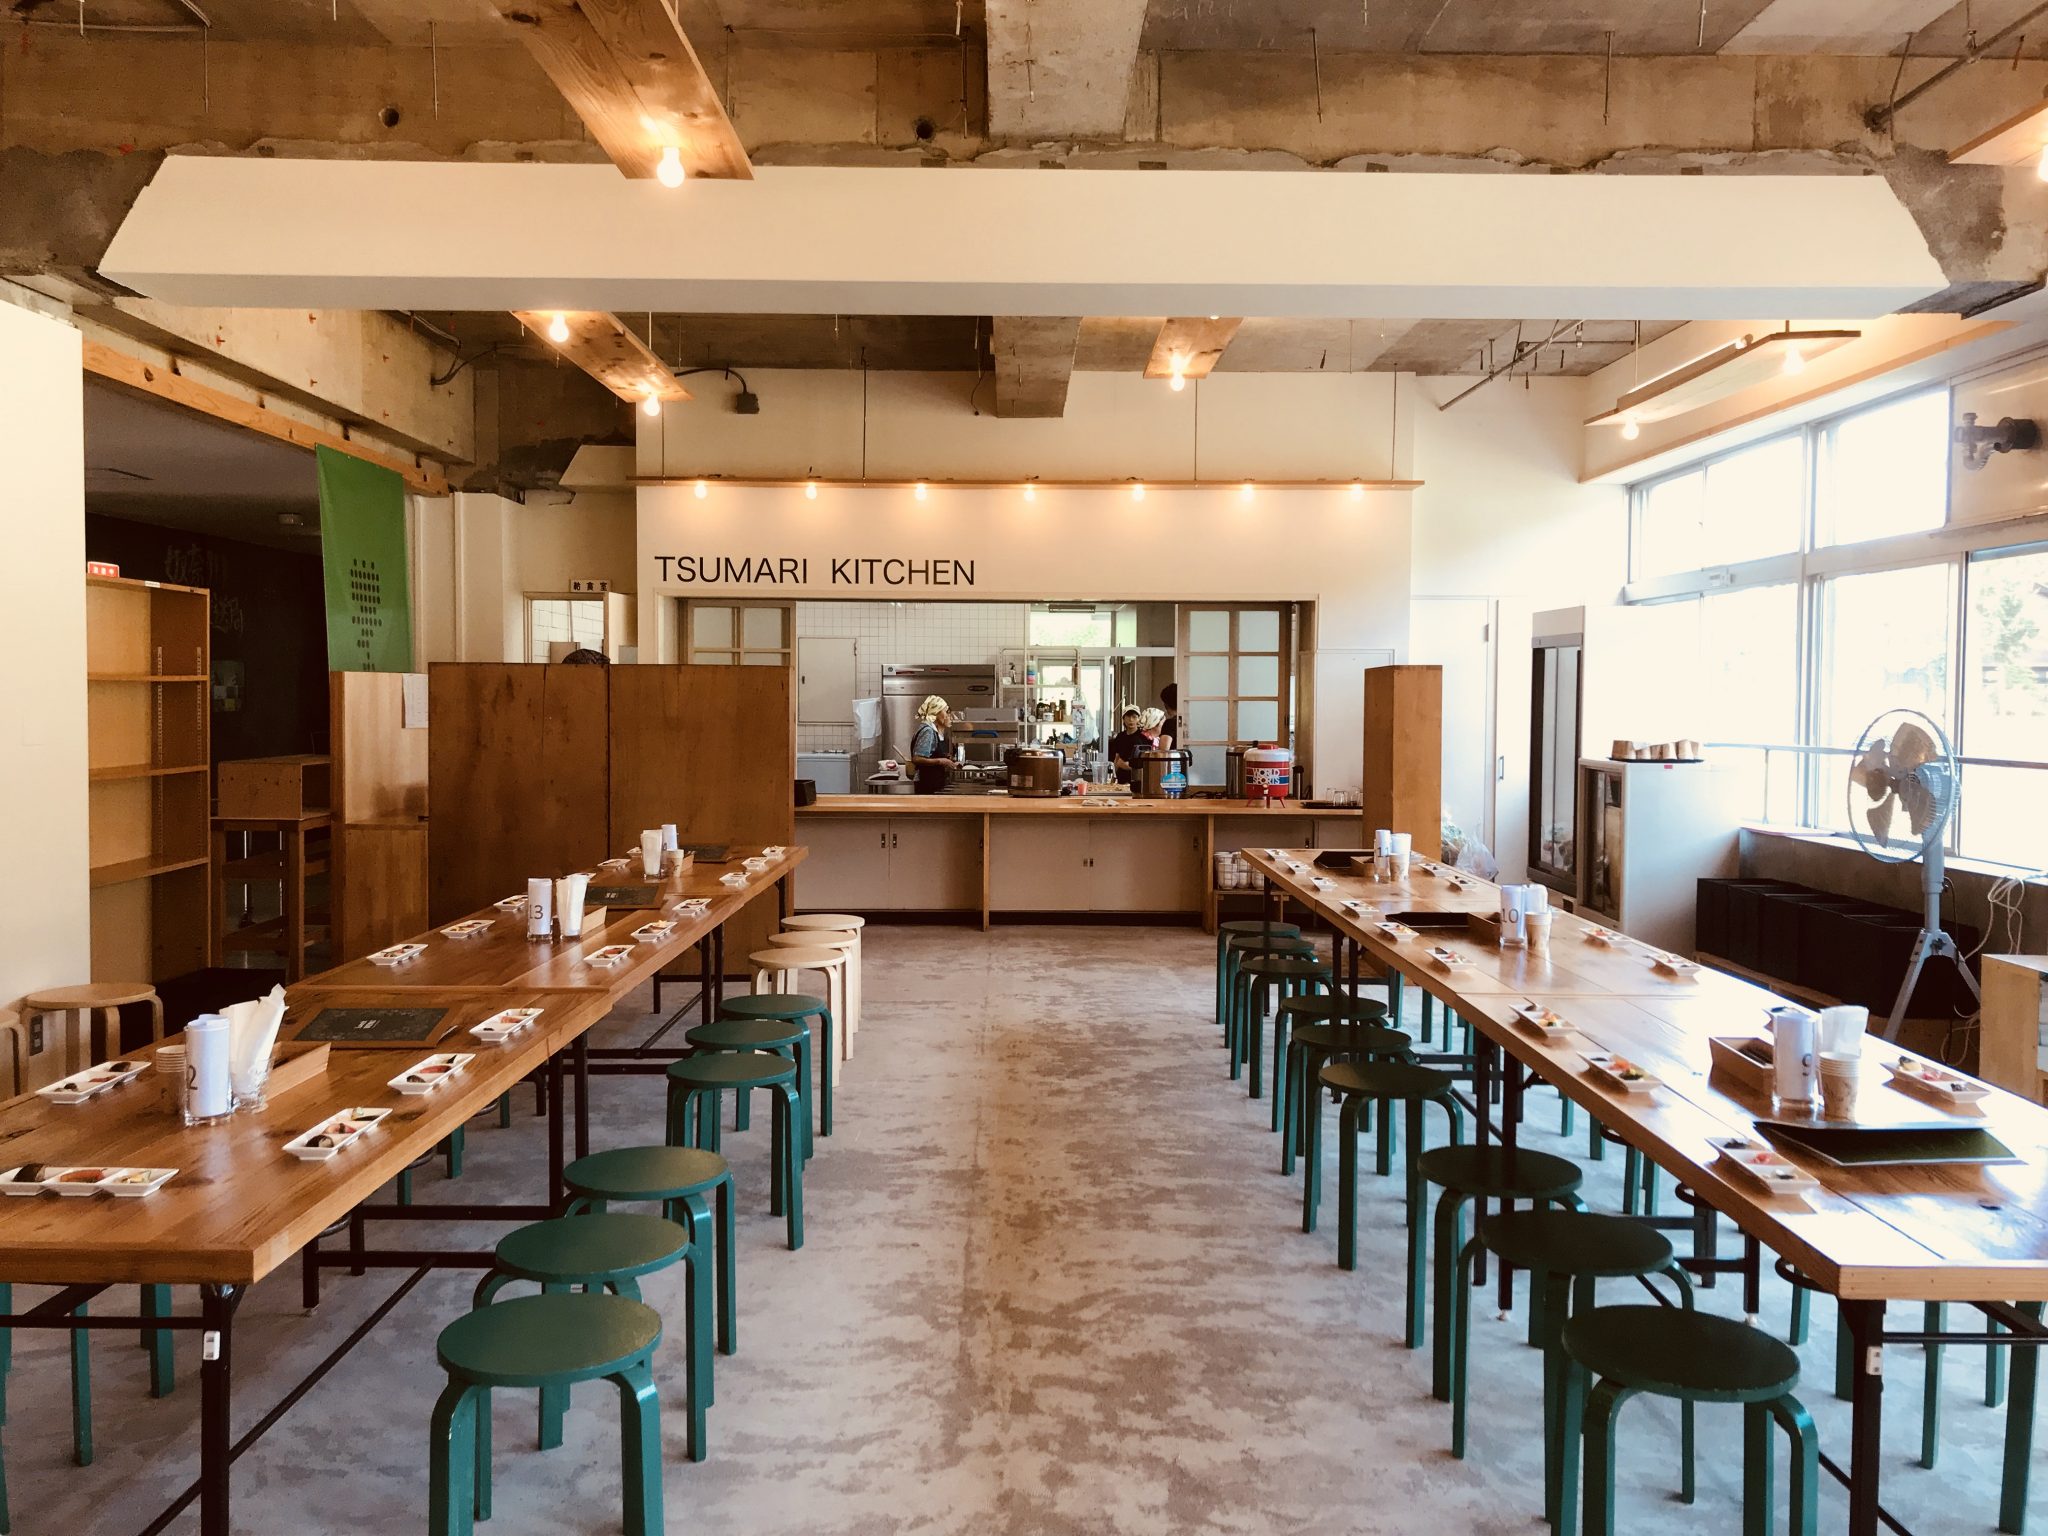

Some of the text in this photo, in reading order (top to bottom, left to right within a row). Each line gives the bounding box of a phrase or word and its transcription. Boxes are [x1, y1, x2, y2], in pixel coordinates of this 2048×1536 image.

[654, 556, 975, 586] TSUMARI KITCHEN
[1252, 768, 1281, 777] WORLD
[1500, 908, 1519, 924] 10
